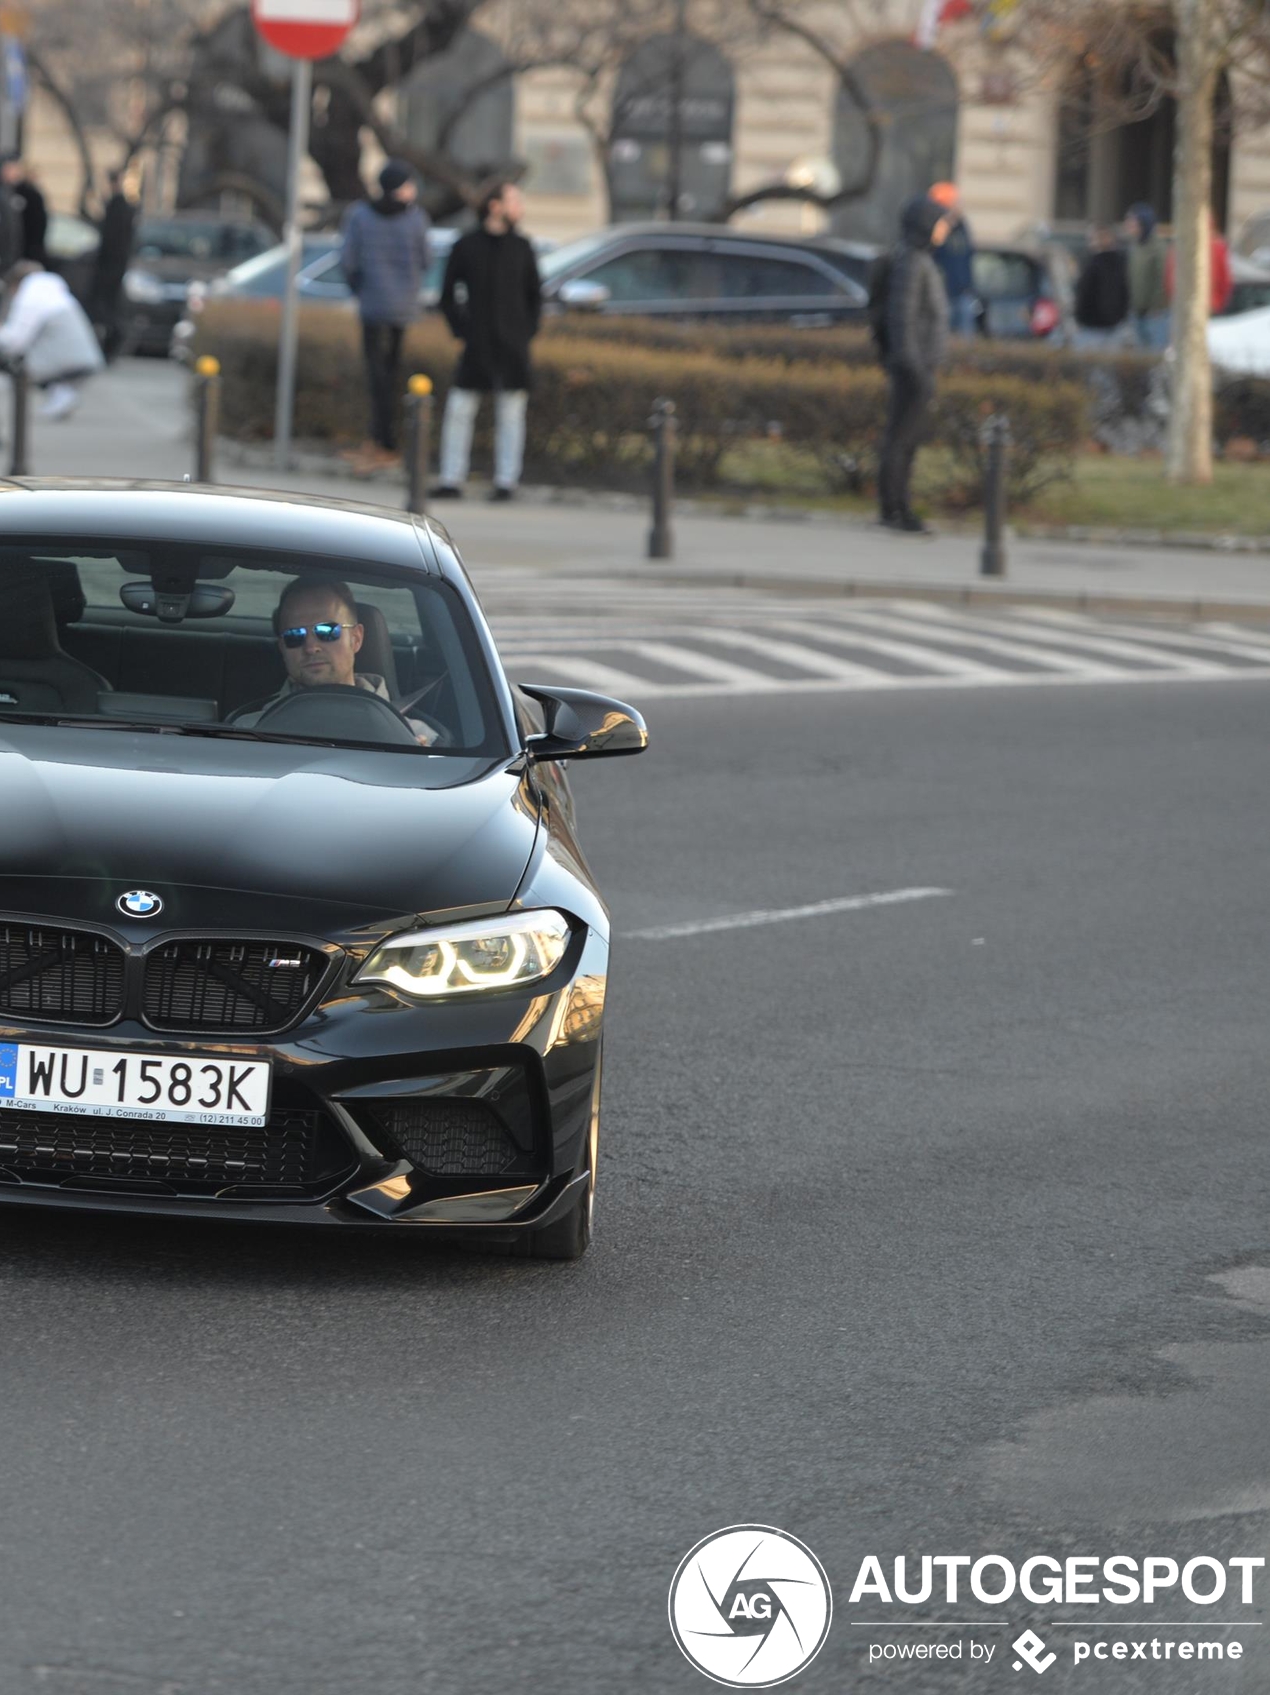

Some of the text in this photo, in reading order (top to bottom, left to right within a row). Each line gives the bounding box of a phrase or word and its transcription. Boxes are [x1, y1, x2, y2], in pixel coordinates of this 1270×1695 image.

[29, 1050, 256, 1112] WU 1583K
[5, 1099, 262, 1126] M-Cars Kraków ul. J. Conrada 20 (12) 211 45 00
